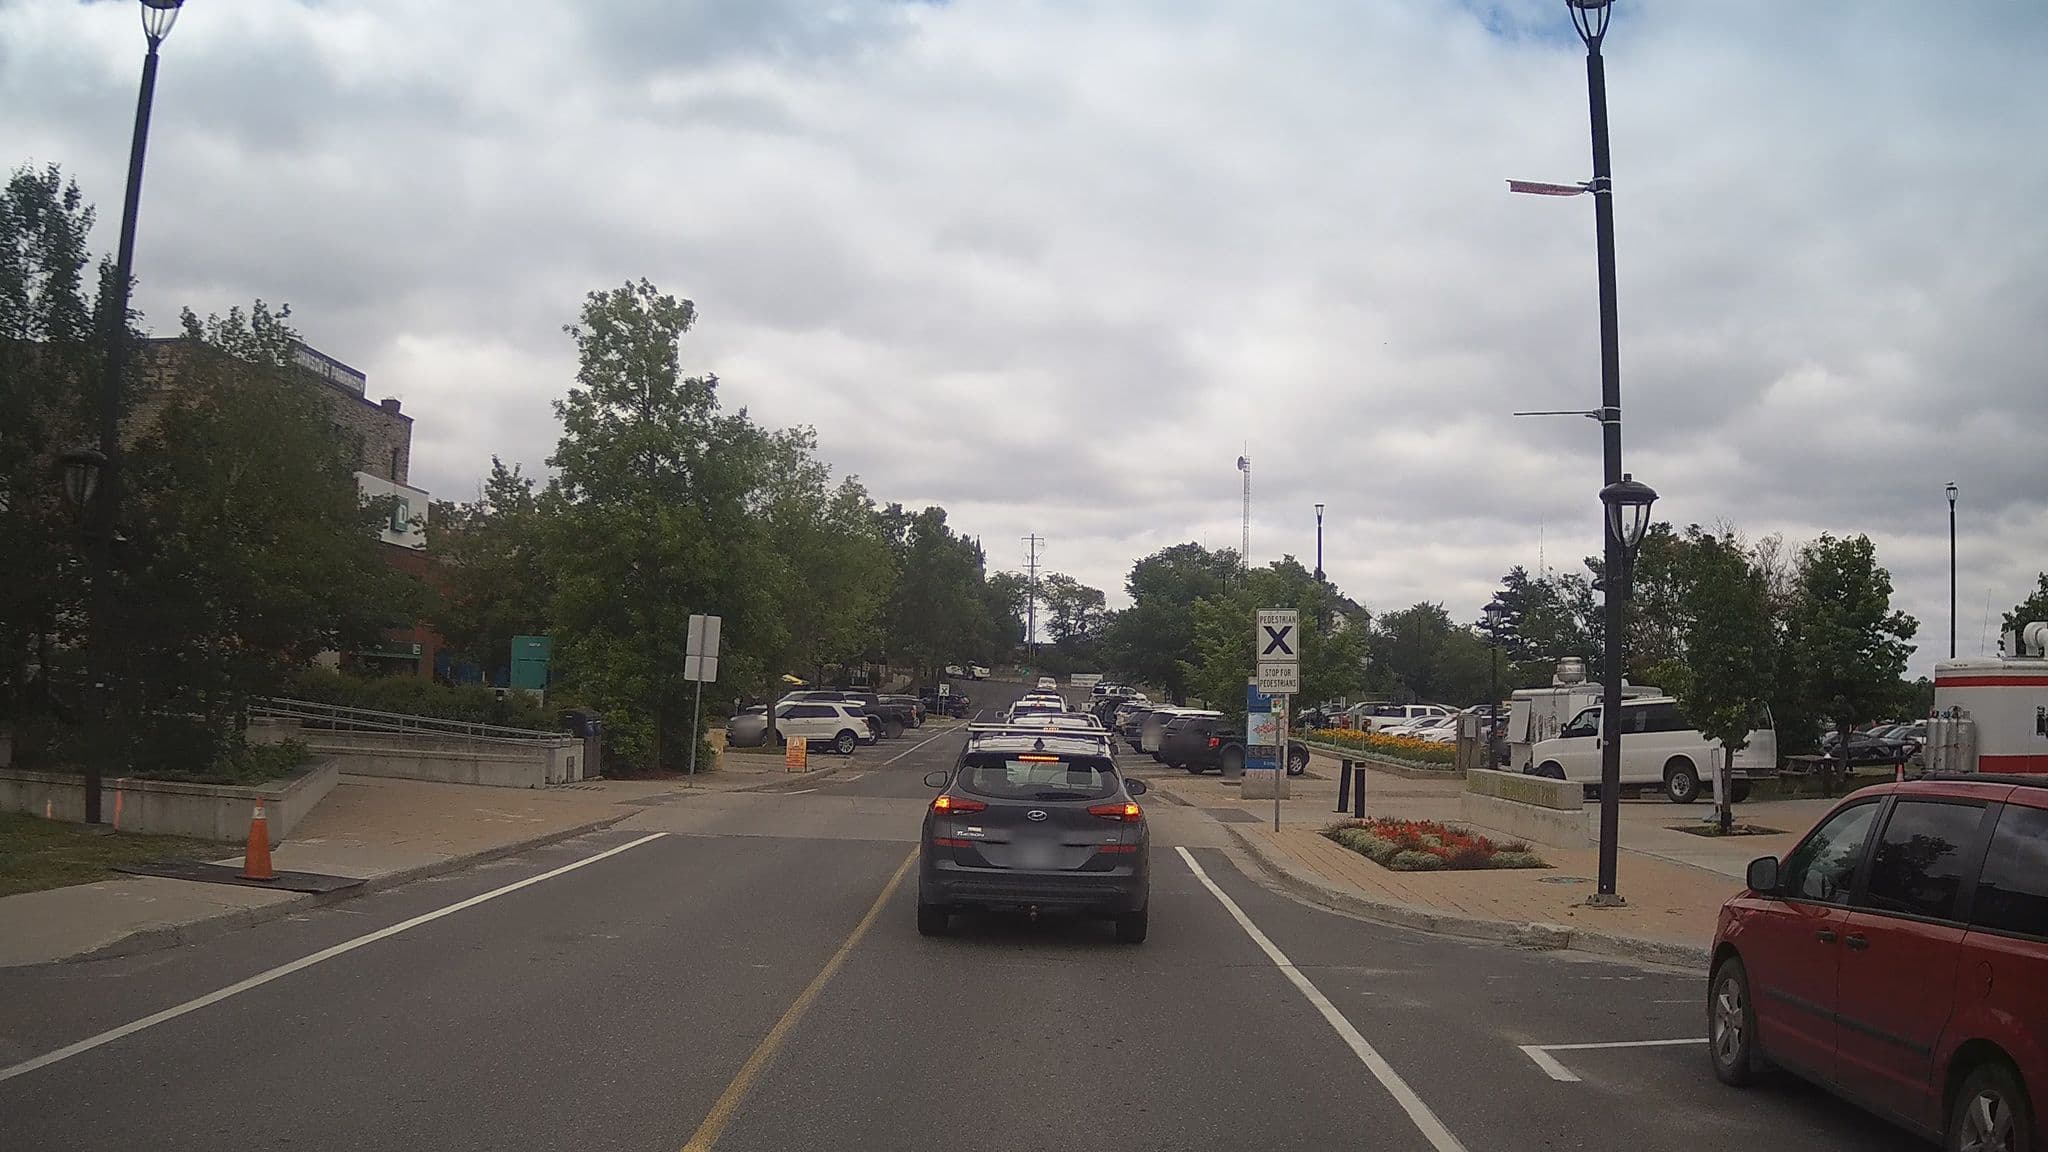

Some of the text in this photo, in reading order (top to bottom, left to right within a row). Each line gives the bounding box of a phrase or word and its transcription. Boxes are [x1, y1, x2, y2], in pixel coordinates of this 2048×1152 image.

[1260, 616, 1296, 624] PEDESTRIAN
[1262, 626, 1294, 655] X
[1265, 669, 1292, 677] STOP FOR
[1260, 679, 1297, 688] PEDESTRIANS
